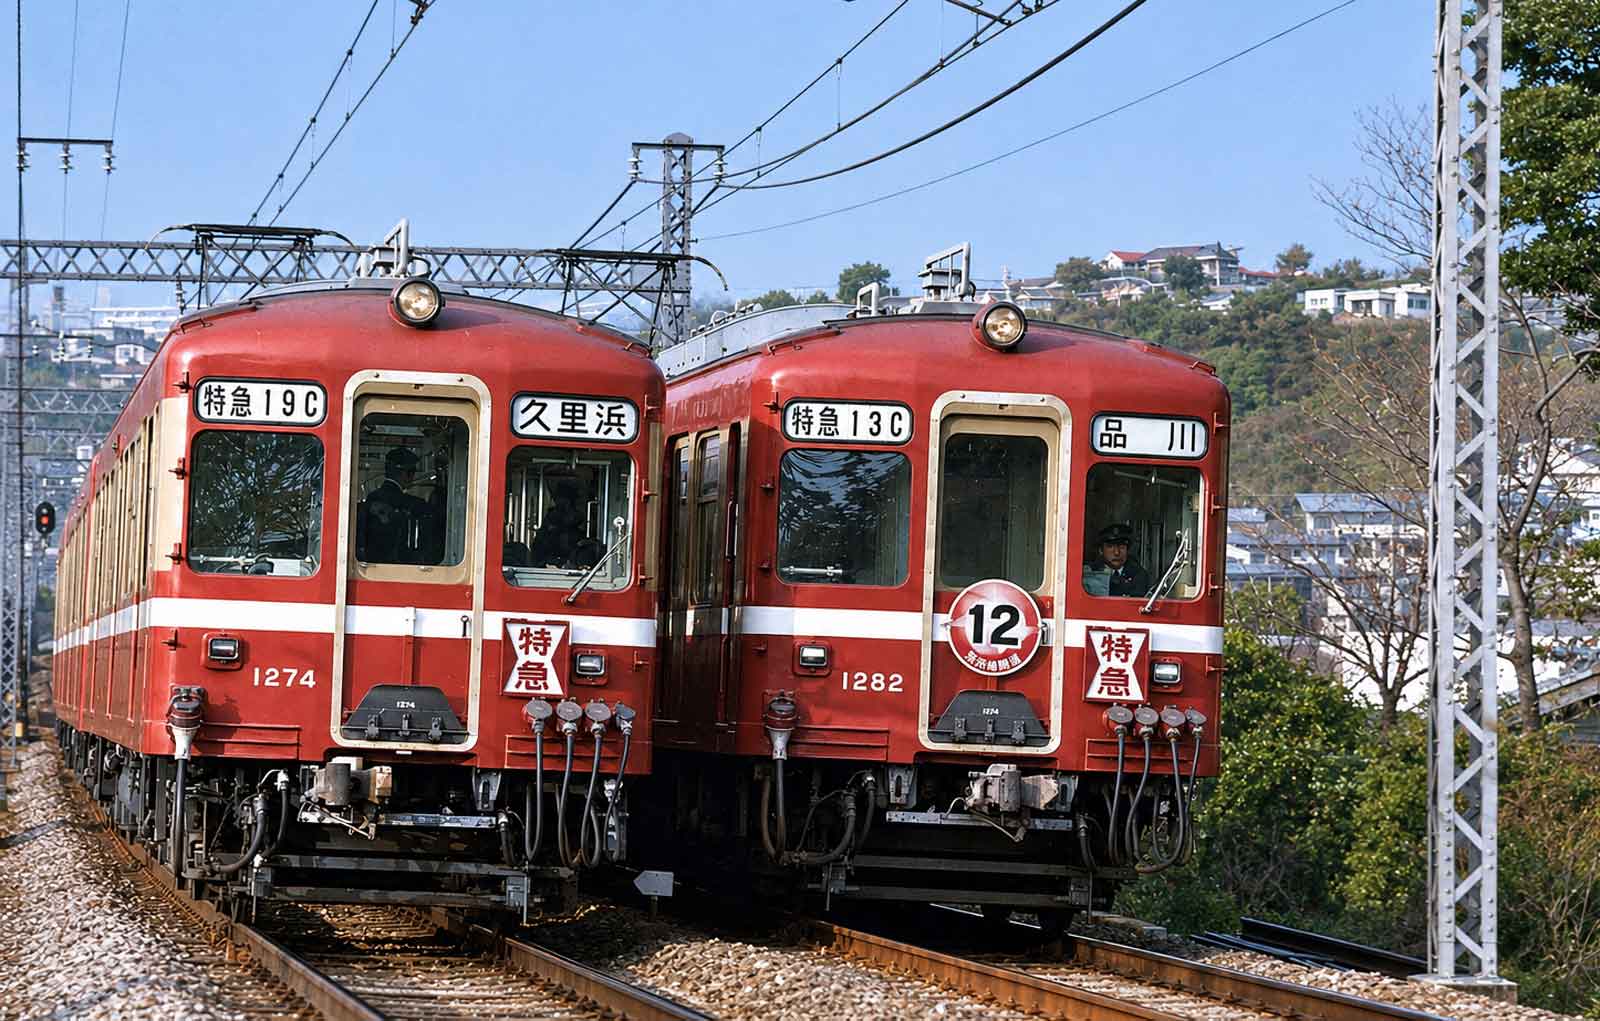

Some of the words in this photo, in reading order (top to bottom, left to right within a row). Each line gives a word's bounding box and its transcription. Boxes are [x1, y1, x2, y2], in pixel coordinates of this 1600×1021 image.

[204, 384, 251, 417] 特急
[265, 389, 318, 417] 19C
[520, 399, 627, 437] 久里浜
[792, 405, 839, 436] 特急
[852, 410, 902, 437] 13C
[1100, 419, 1196, 452] 品川
[969, 604, 1019, 646] 12
[515, 627, 552, 690] 特急
[1098, 633, 1133, 696] 特急
[253, 667, 316, 688] 1274
[842, 671, 904, 692] 1282
